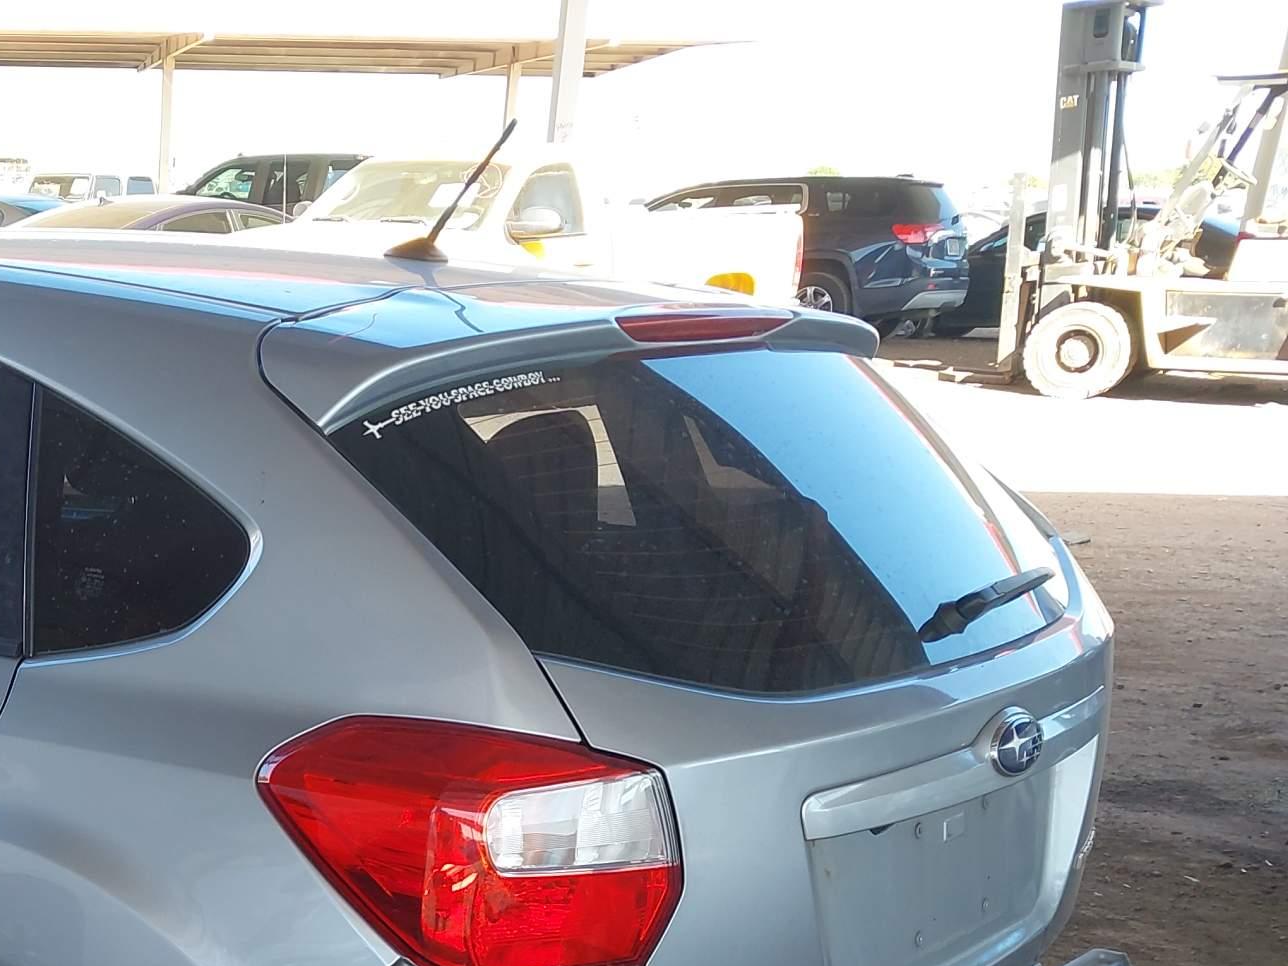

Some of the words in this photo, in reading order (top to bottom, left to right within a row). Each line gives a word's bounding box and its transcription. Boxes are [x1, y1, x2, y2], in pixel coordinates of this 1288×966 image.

[1059, 94, 1080, 110] CAT
[391, 402, 422, 425] SEE
[418, 391, 451, 413] YOU
[451, 381, 495, 403] SPACE
